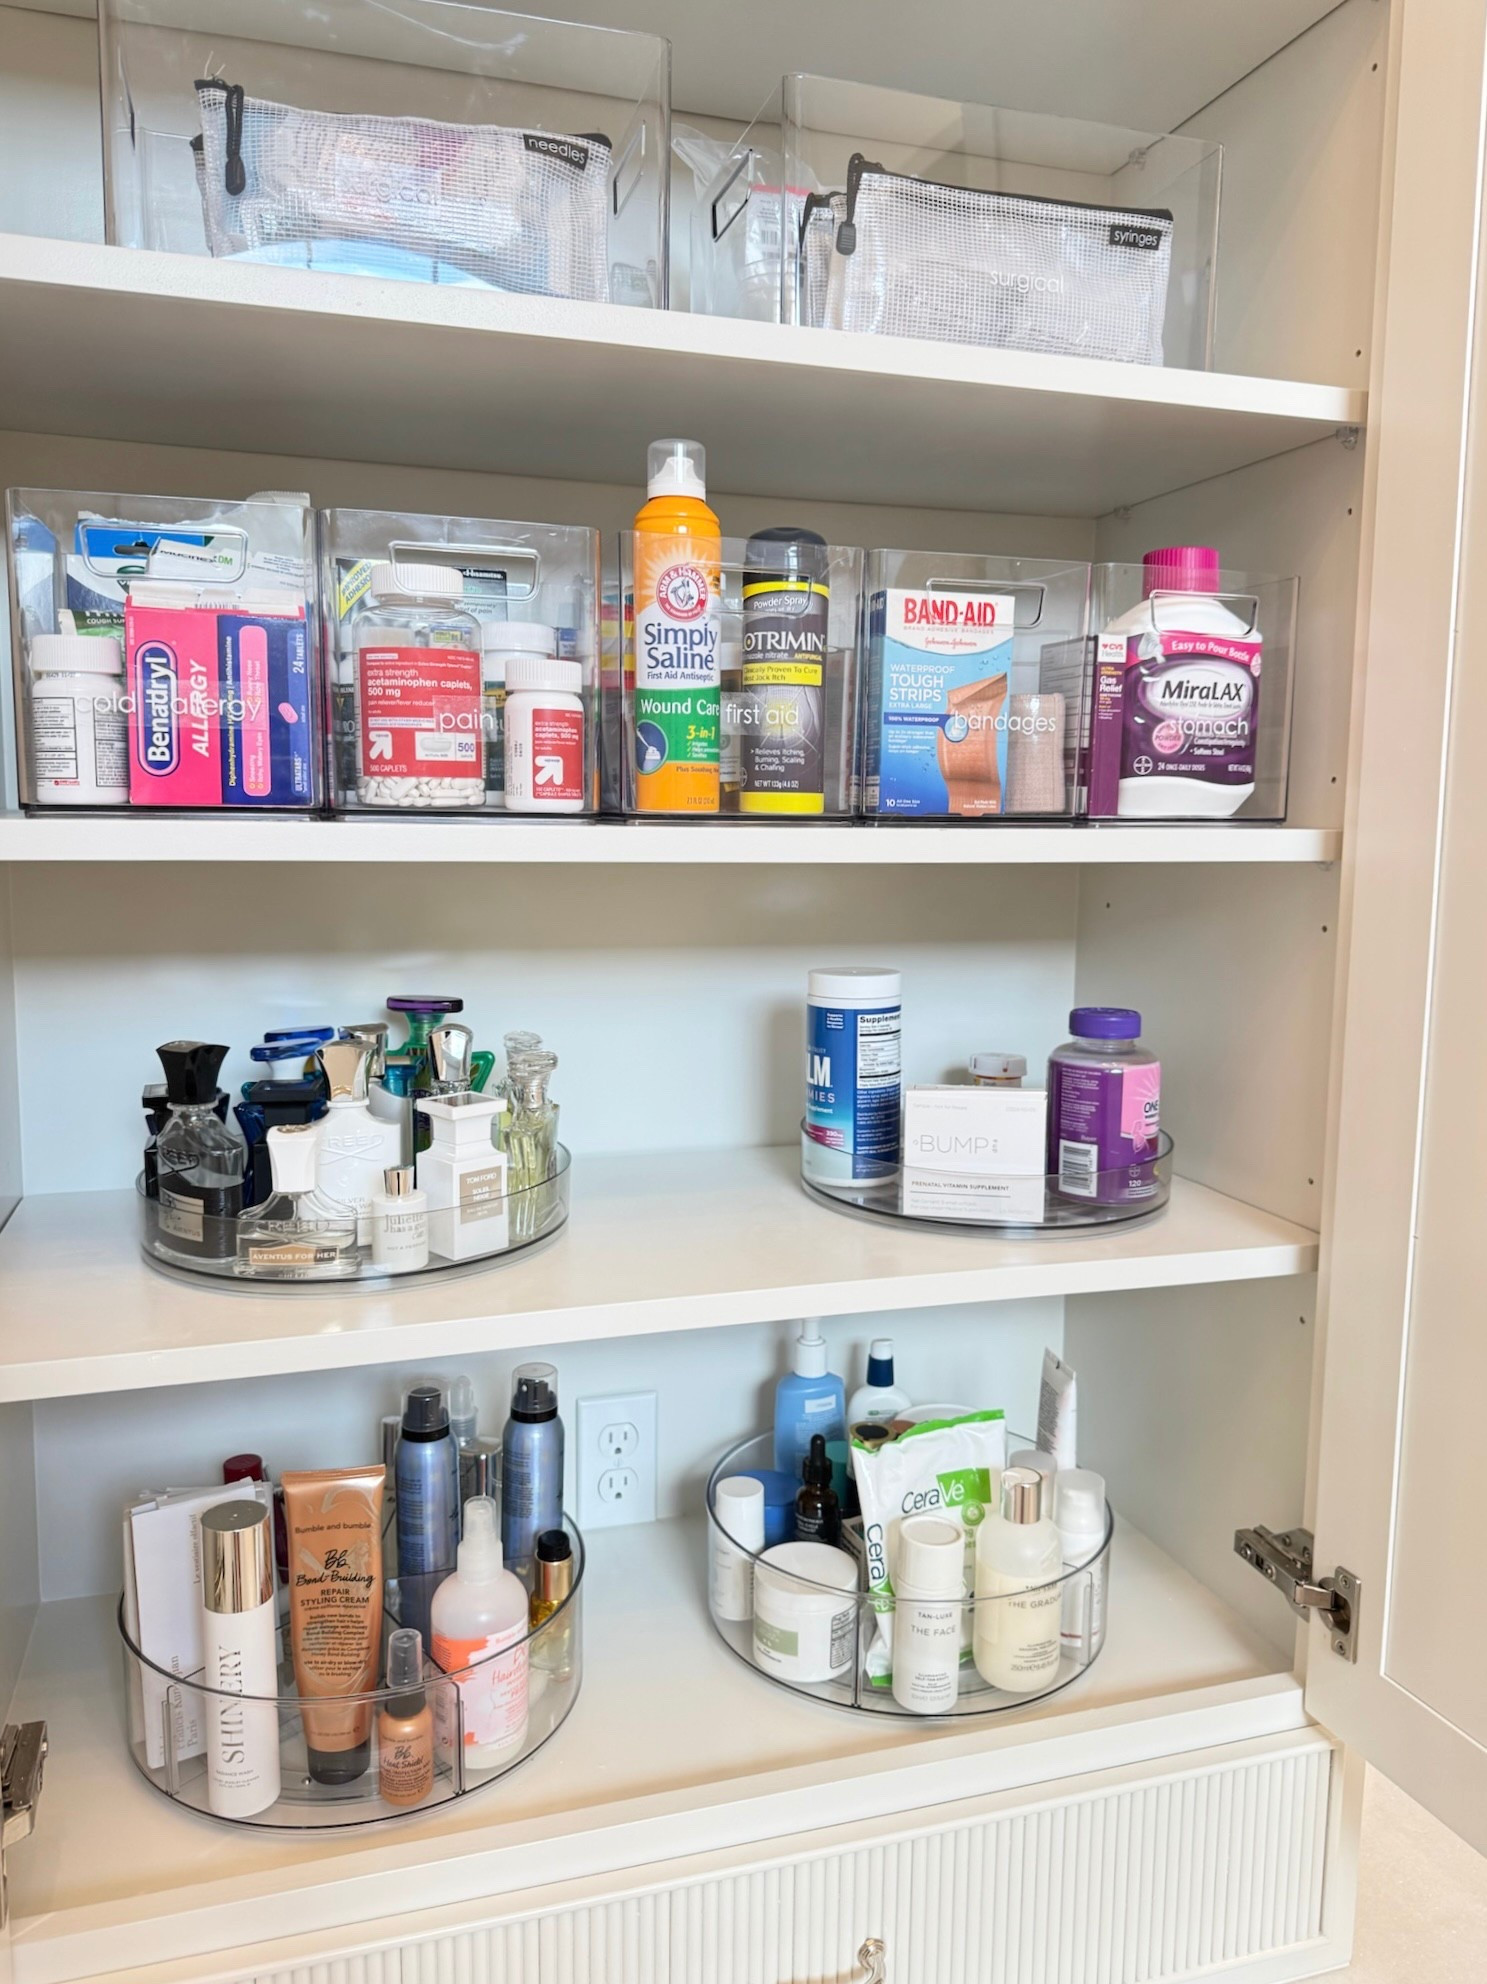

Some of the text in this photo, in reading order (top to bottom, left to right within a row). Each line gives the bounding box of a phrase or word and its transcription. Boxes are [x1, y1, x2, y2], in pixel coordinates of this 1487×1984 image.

[528, 138, 585, 164] needles
[1114, 229, 1159, 248] syringes
[990, 270, 1064, 293] surgical
[218, 555, 234, 566] DM
[345, 575, 372, 605] ADHESIO
[659, 566, 706, 600] ARM & HAMMER
[753, 595, 808, 610] Powder Spray
[903, 597, 996, 627] BAND-AID
[644, 622, 718, 653] Simply
[743, 631, 823, 652] OTRIMIN
[293, 633, 304, 674] 24 TABLETS
[1171, 640, 1194, 651] Easy
[1195, 641, 1206, 650] to
[1207, 641, 1228, 655] Pour
[646, 646, 714, 671] Saline
[765, 651, 789, 660] nitrate
[367, 669, 418, 678] extra strength
[803, 666, 818, 674] Cure
[889, 663, 955, 674] WATERPROOF
[647, 671, 714, 683] First Aid Antiseptic
[889, 673, 944, 687] TOUGH
[1100, 676, 1117, 684] Gas
[367, 678, 473, 691] acetaminophen caplets,
[1099, 684, 1123, 692] Relief
[1161, 680, 1244, 702] MiraLAX
[368, 687, 401, 698] 500 mg
[889, 688, 942, 702] STRIPS
[76, 691, 136, 713] cold
[145, 656, 177, 762] Benadryl
[189, 659, 210, 758] ALLERGY
[641, 698, 720, 716] Wound Care
[225, 635, 236, 787] Diphenhydramine Antihistamine
[725, 703, 799, 725] first aid
[439, 708, 494, 734] pain
[953, 711, 1057, 735] bandages
[1169, 716, 1248, 735] stomach
[686, 725, 716, 739] 3-in-1
[458, 743, 475, 753] 500
[754, 748, 805, 757] Relieves Itching,
[755, 756, 805, 766] Burning, Scaling
[760, 763, 785, 773] Chafing
[1157, 762, 1166, 770] 24
[380, 765, 408, 773] CAPLETS
[885, 799, 896, 807] 10
[919, 1134, 989, 1154] BUMP
[466, 1172, 497, 1184] TOM FORD
[911, 1180, 941, 1188] PRENATAL
[316, 1251, 337, 1259] HER
[901, 1479, 965, 1514] CeraVe
[295, 1525, 325, 1534] Bumble
[326, 1522, 341, 1530] and
[866, 1523, 894, 1611] CeraVe
[295, 1570, 376, 1589] Bond-Building
[320, 1588, 350, 1596] REPAIR
[301, 1596, 370, 1607] STYLING CREAM
[1007, 1597, 1027, 1609] THE
[918, 1611, 953, 1620] TAN-LUXE
[910, 1624, 956, 1637] THE FACE
[219, 1645, 244, 1764] SHINERY
[187, 1719, 198, 1748] Paris
